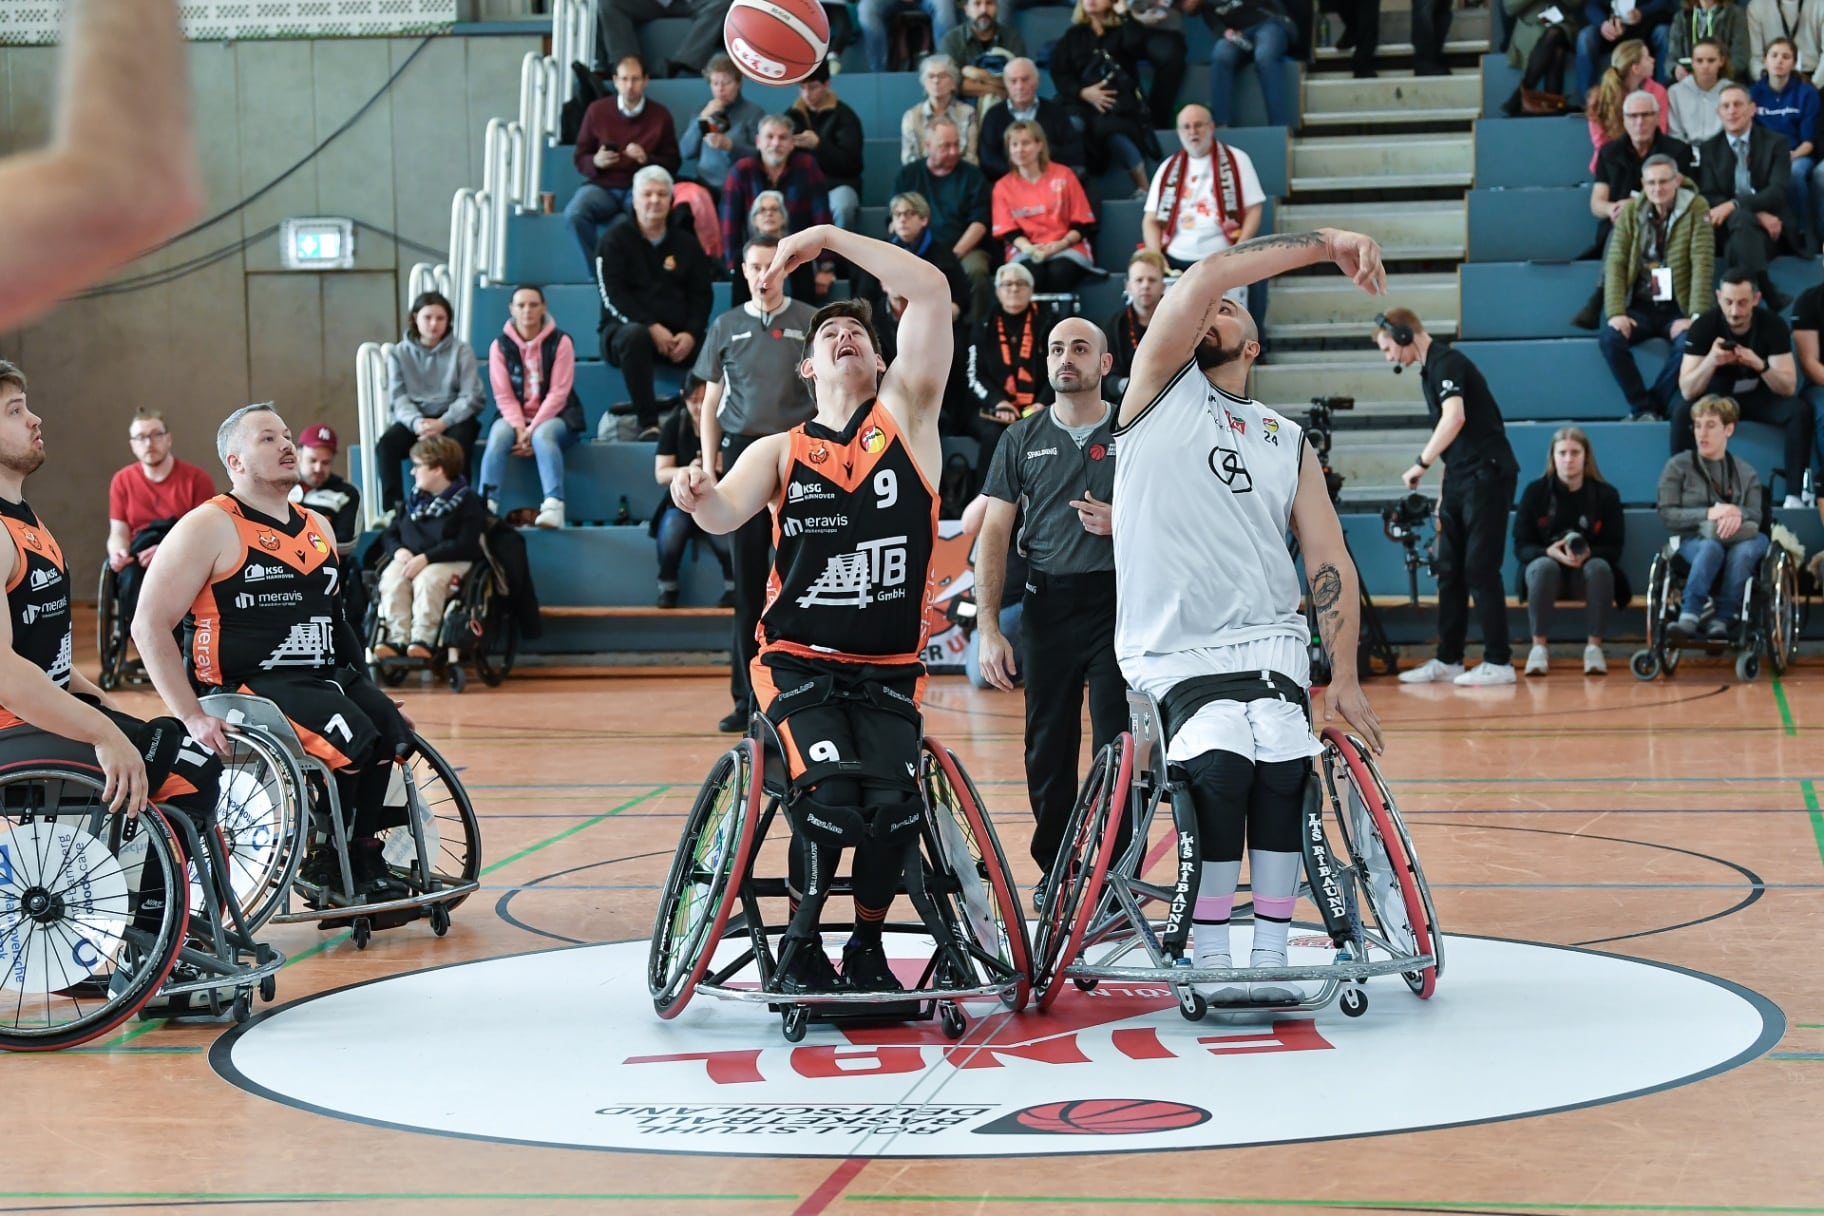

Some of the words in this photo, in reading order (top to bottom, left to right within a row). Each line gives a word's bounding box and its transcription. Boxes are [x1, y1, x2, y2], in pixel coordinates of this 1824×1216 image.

[1263, 430, 1279, 447] 24
[1027, 447, 1058, 460] SPALDING
[802, 483, 822, 494] KSG
[873, 468, 899, 510] 9
[266, 566, 284, 574] KSG
[322, 566, 339, 596] 7
[258, 590, 303, 603] meravis
[877, 588, 906, 601] GmbH
[323, 712, 354, 744] 7
[808, 740, 841, 762] 9
[1307, 813, 1323, 841] LTS
[1179, 831, 1195, 859] LTS
[5, 891, 25, 984] Hannoversche
[622, 1018, 1336, 1085] FINAL
[594, 1106, 992, 1116] DEUTSCHLAND
[634, 1116, 970, 1126] BASKETBALL
[637, 1126, 948, 1135] ROLLSTUHL
